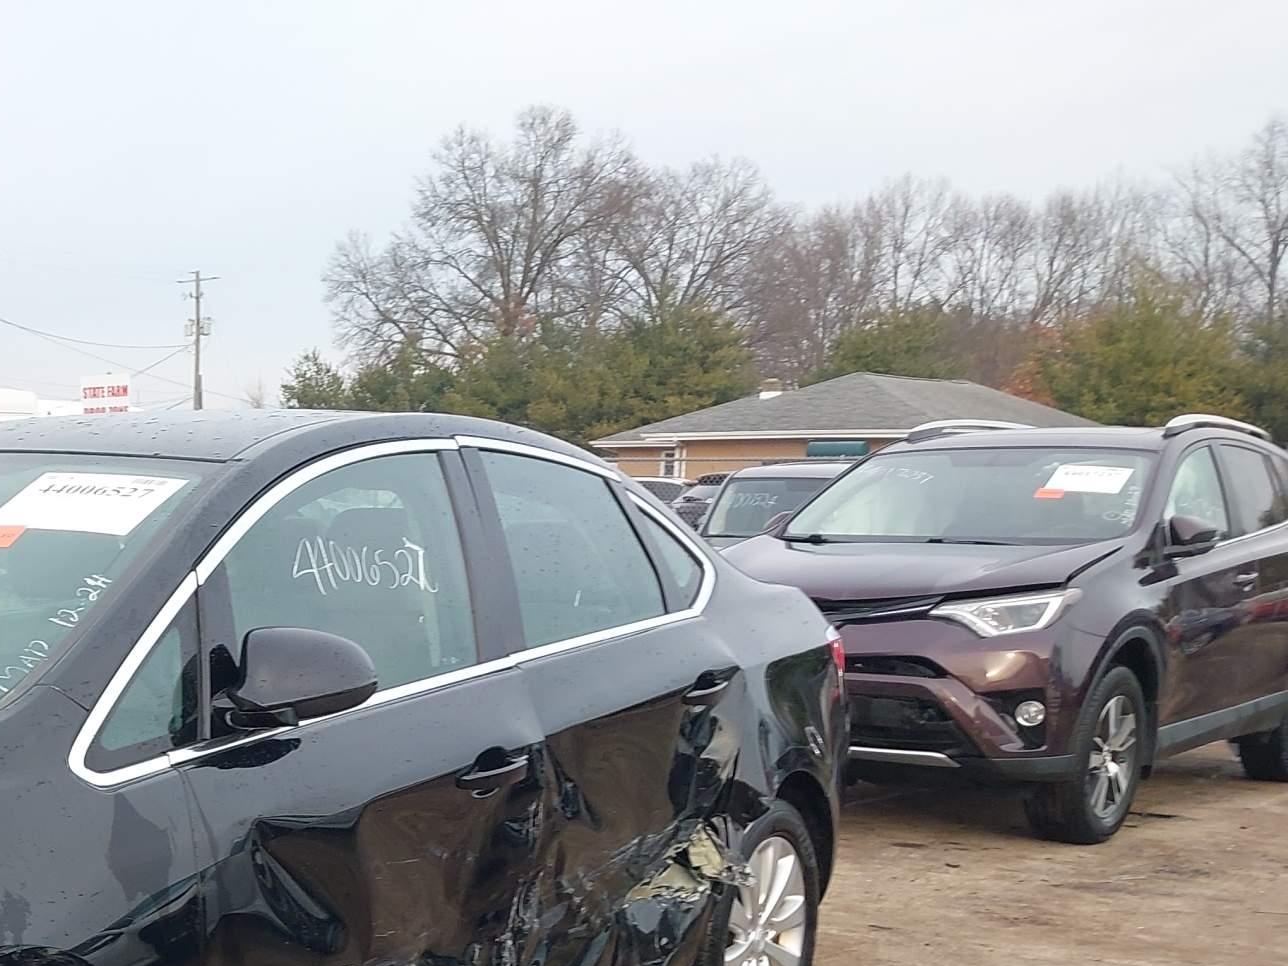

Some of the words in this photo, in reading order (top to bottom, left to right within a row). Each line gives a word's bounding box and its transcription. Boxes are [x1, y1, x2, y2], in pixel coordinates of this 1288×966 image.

[83, 386, 105, 399] STATE
[107, 385, 128, 397] FARM
[38, 483, 156, 499] 44006527
[292, 536, 439, 595] 44006527
